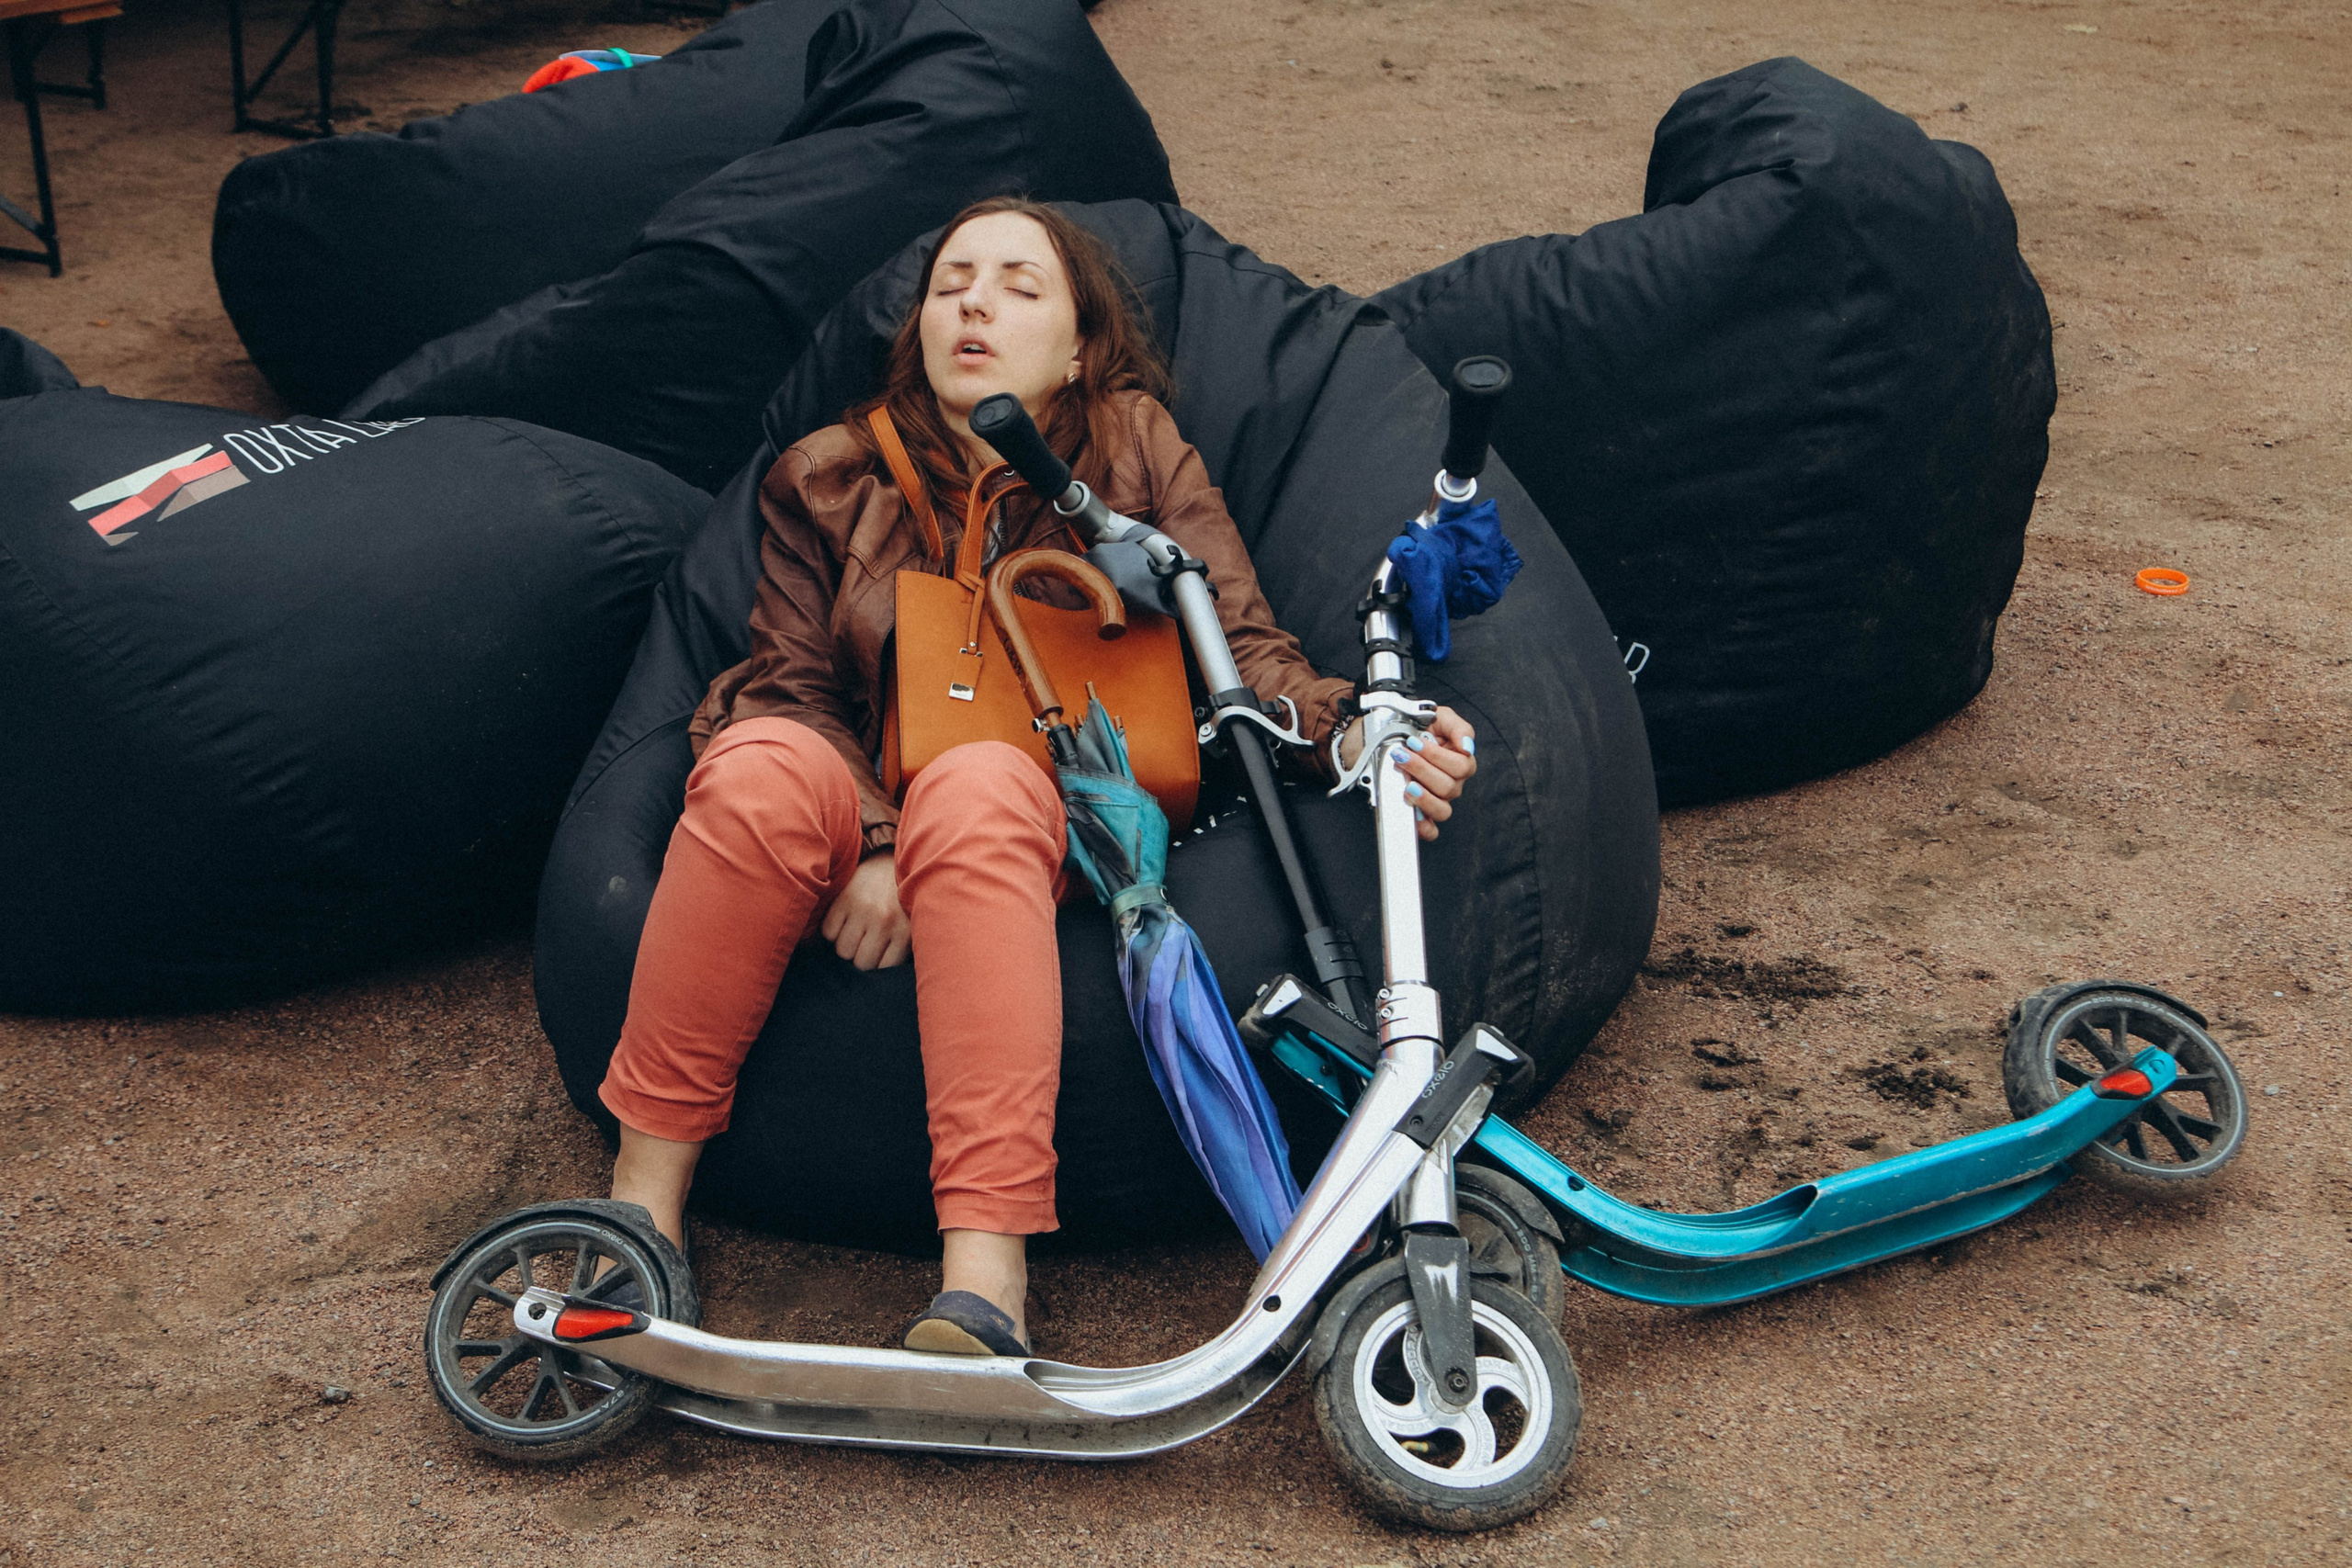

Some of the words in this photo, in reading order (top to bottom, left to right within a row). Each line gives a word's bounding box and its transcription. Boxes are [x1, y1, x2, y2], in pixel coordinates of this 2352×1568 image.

[222, 423, 358, 474] OXTA
[601, 1229, 624, 1245] oxelo
[1516, 1229, 1532, 1252] 200
